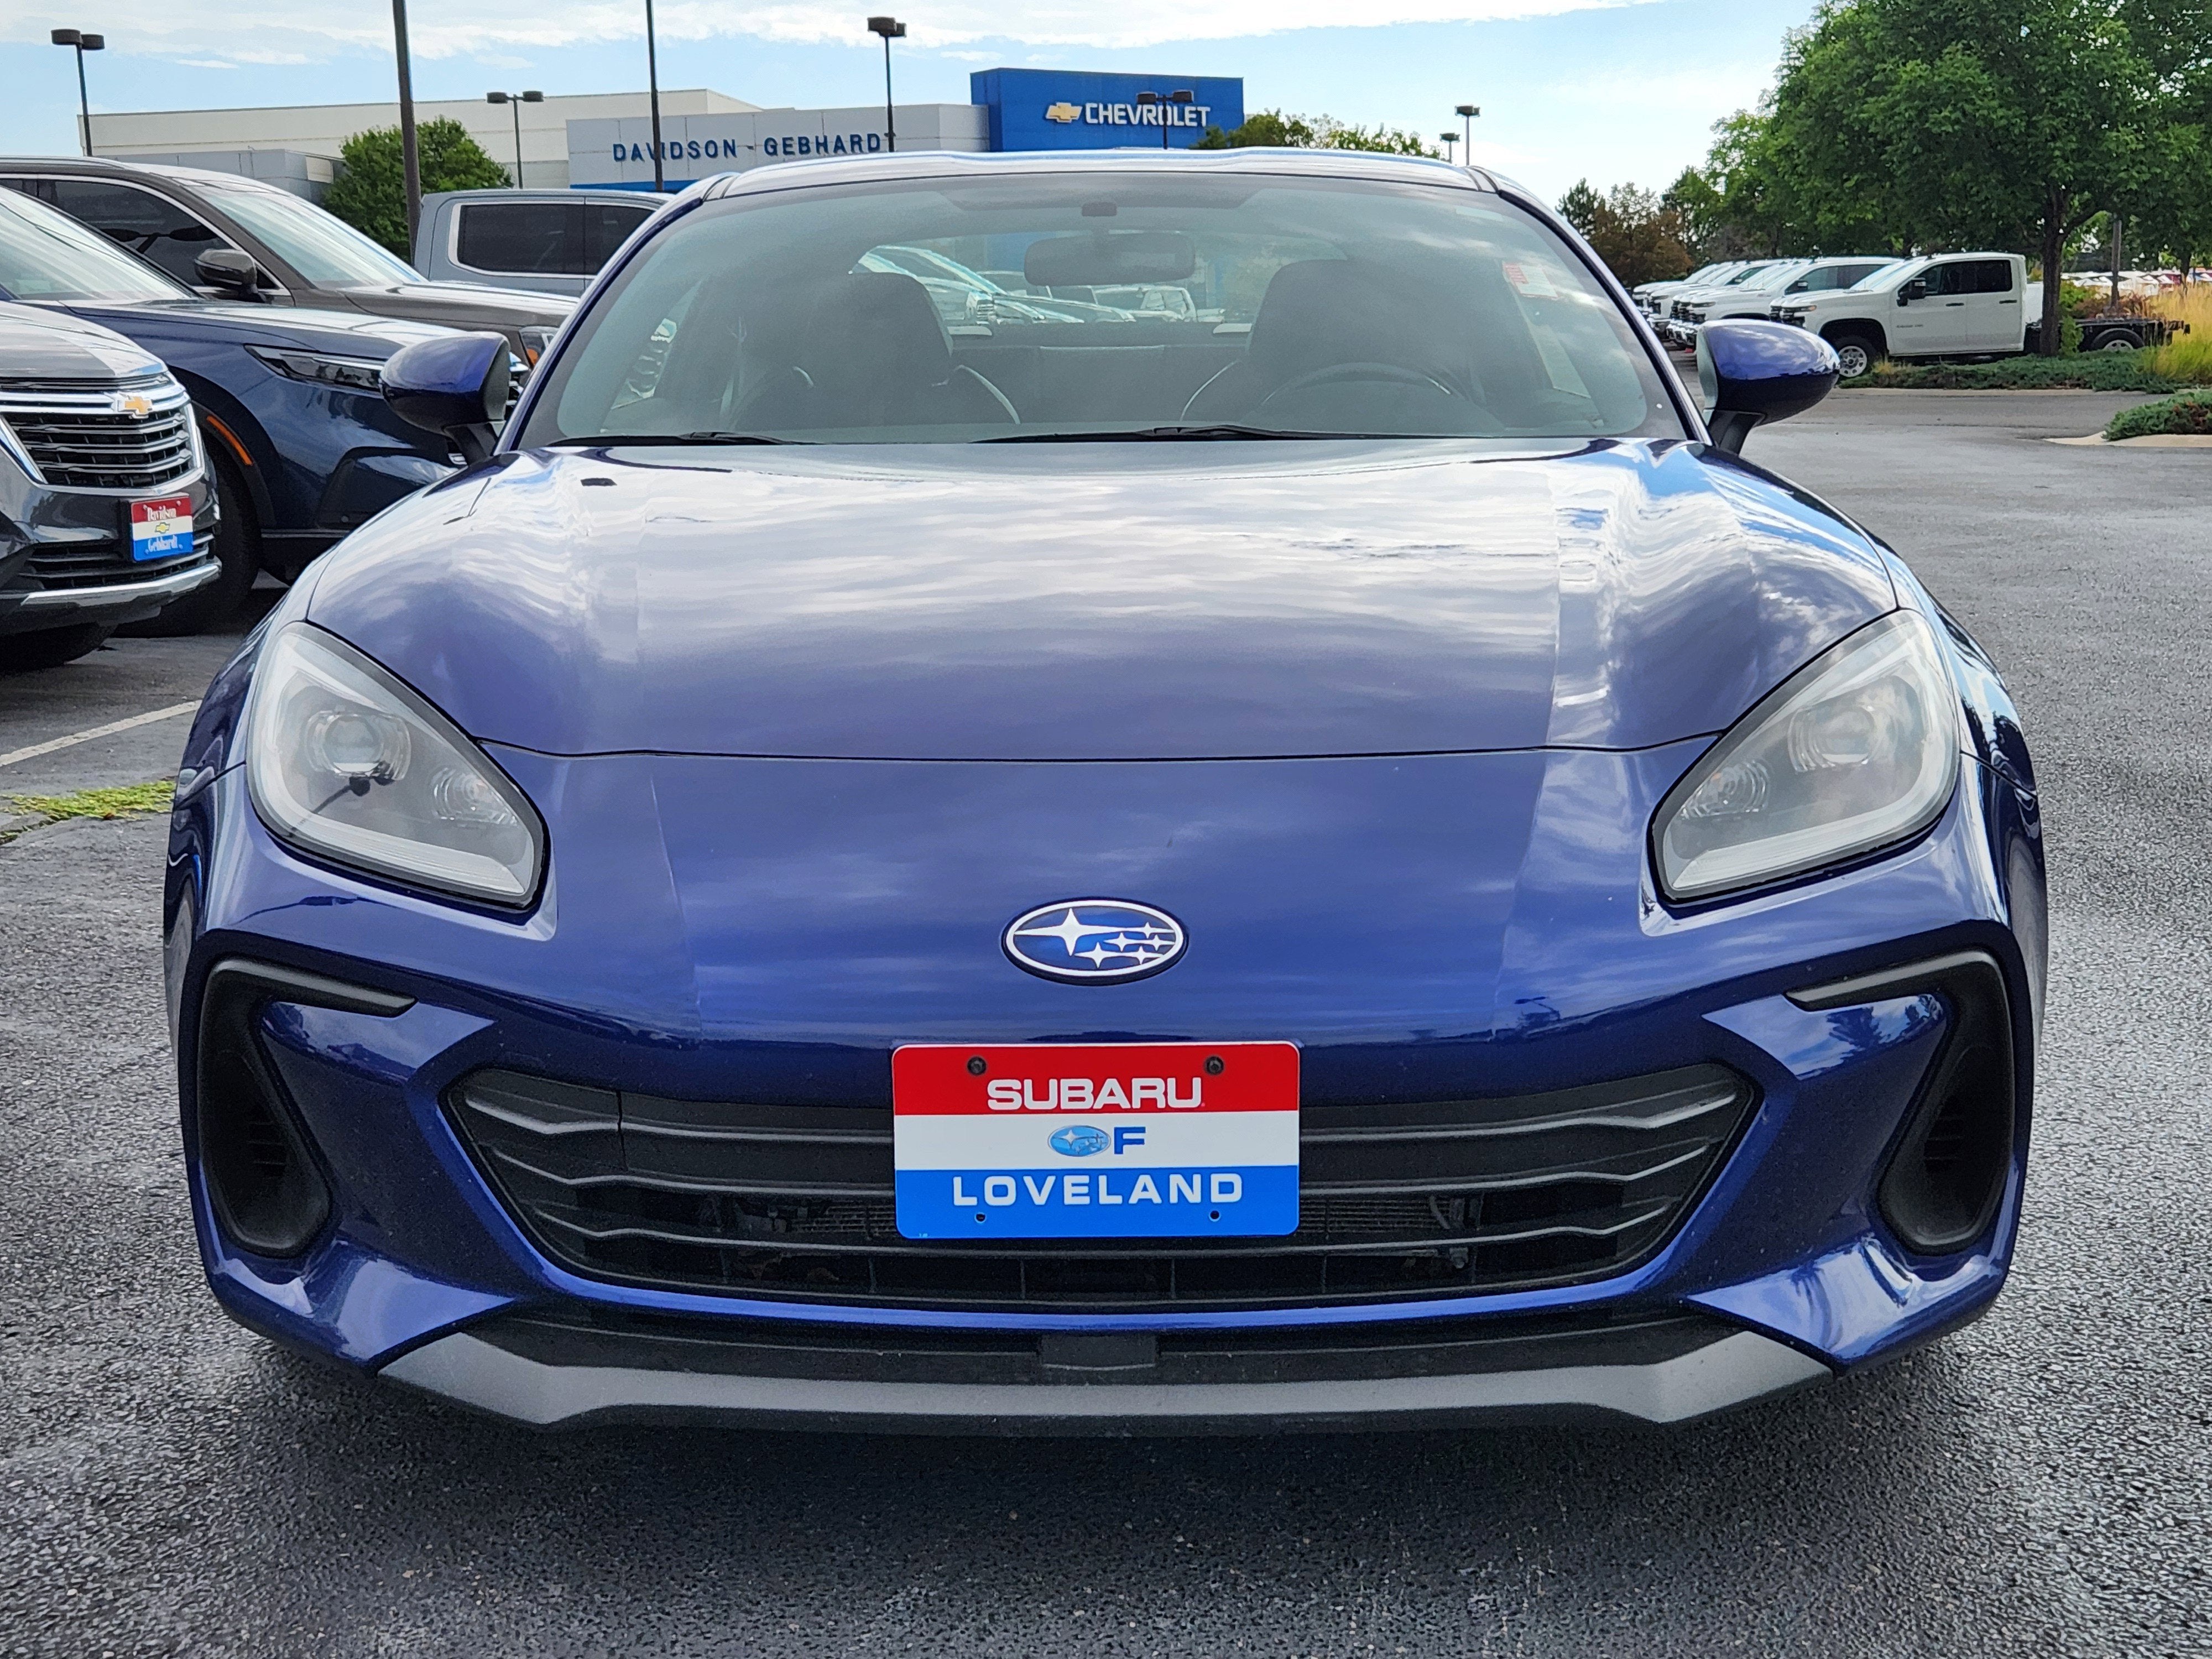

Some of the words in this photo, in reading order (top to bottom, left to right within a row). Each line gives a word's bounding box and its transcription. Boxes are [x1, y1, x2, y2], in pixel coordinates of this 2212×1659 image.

[1084, 102, 1211, 127] CHEVROLET
[987, 1077, 1202, 1110] SUBARU
[952, 1172, 1243, 1206] LOVELAND
